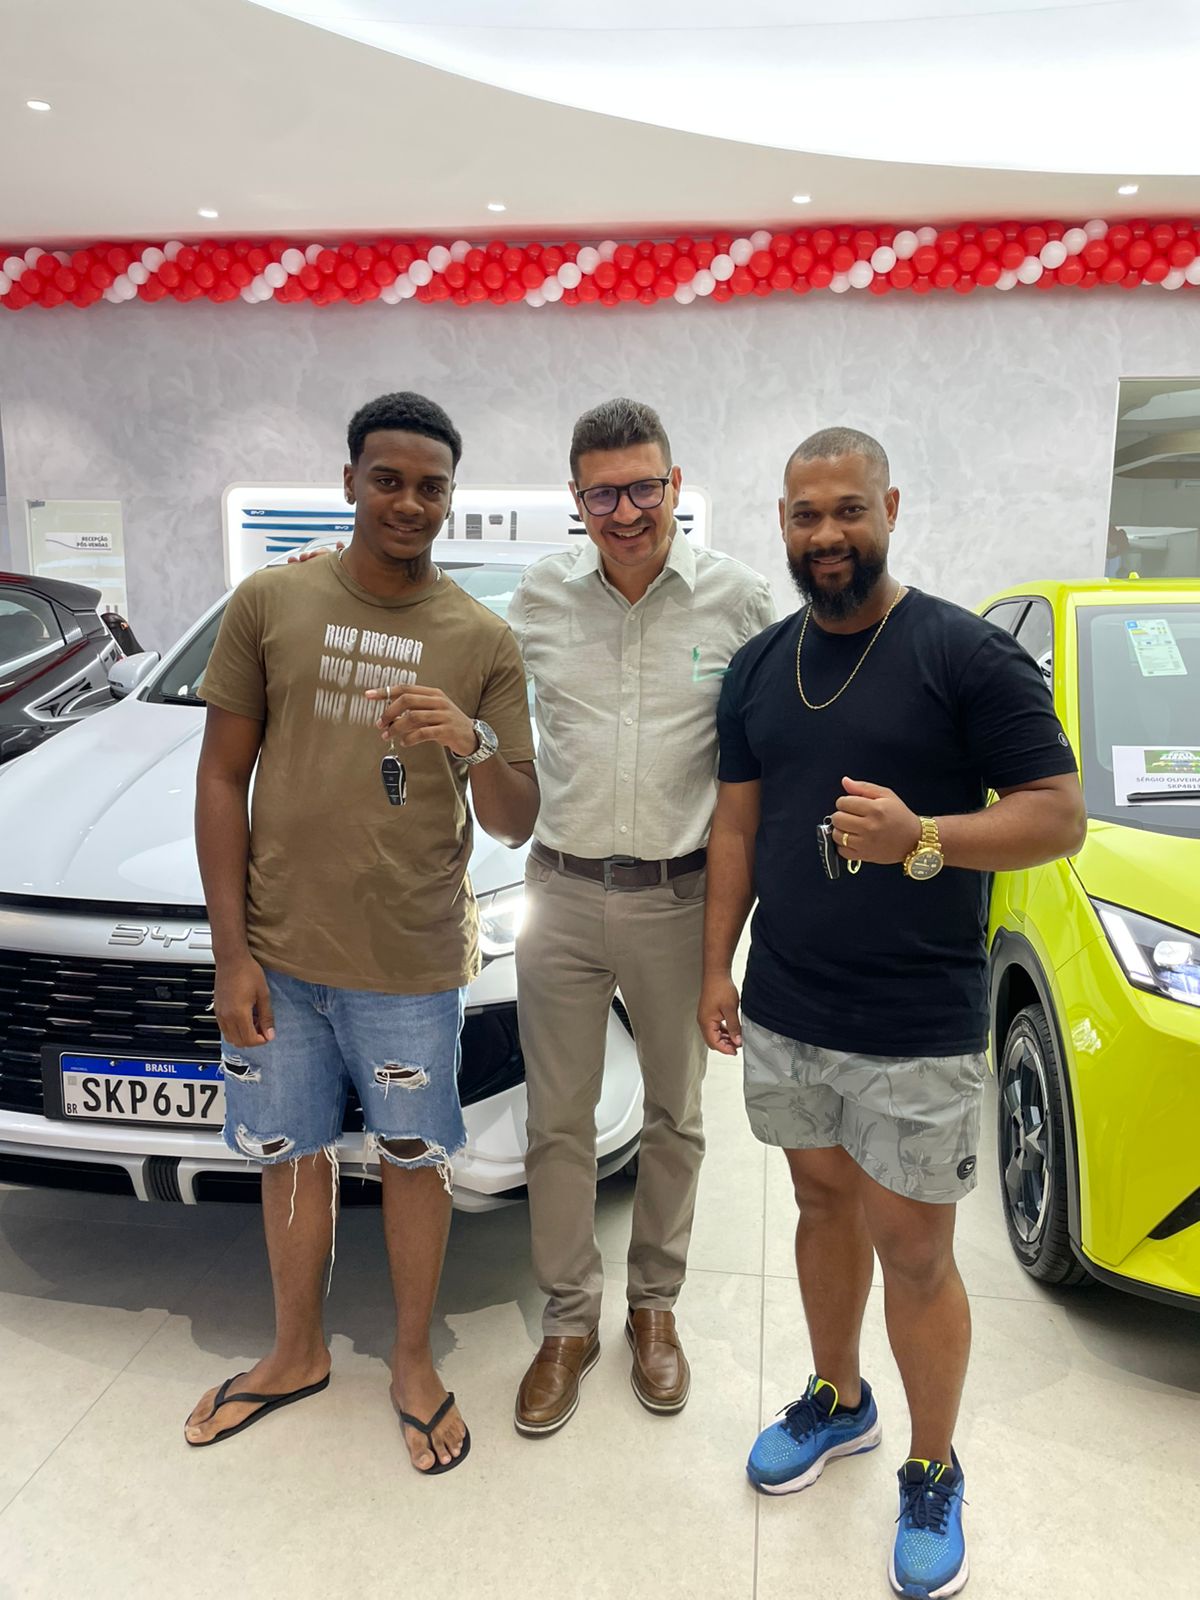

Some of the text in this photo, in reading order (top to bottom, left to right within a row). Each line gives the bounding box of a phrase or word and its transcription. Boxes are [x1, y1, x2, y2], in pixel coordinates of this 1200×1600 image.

[145, 1063, 177, 1074] BRASIL
[81, 1077, 219, 1119] SKP6J7
[66, 1102, 78, 1115] BR
